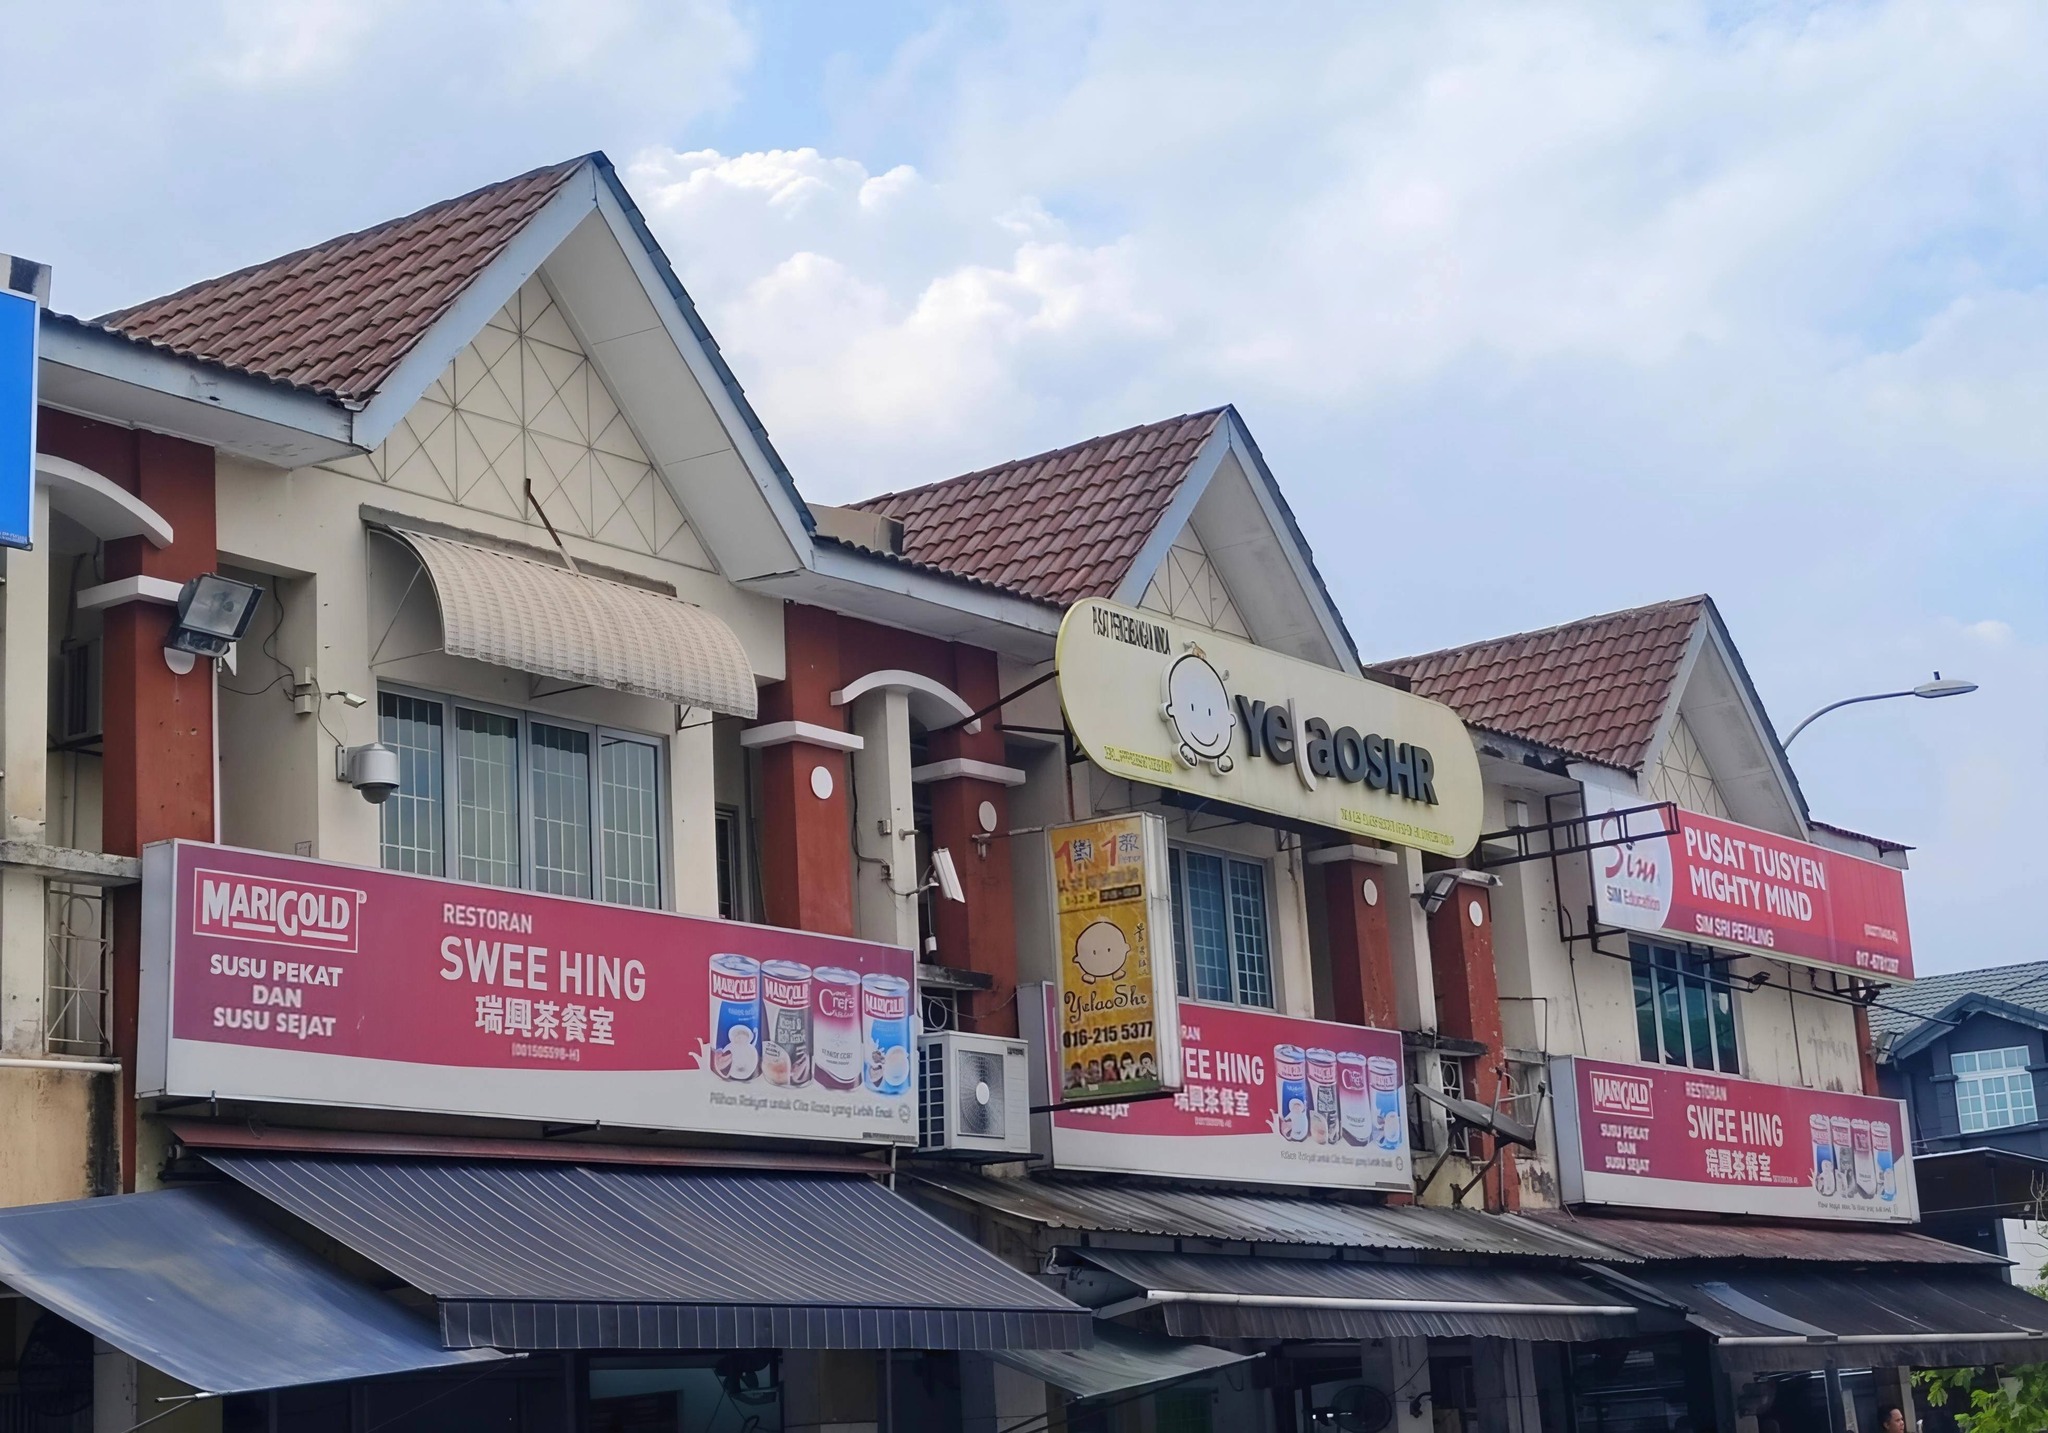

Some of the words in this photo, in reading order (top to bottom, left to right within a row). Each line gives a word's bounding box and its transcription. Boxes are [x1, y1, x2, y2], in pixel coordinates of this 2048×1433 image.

[1684, 826, 1746, 870] PUSAT
[1748, 843, 1826, 891] TUISYEN
[202, 879, 350, 937] MARIGOLD
[1689, 864, 1760, 910] MIGHTY
[1764, 882, 1812, 921] MIND
[443, 903, 533, 935] RESTORAN
[1695, 913, 1714, 934] SIM
[1714, 917, 1731, 939] SRI
[1731, 921, 1774, 947] PETALING
[210, 953, 267, 980] SUSU
[272, 960, 344, 988] PEKAT
[440, 935, 548, 992] SWEE
[560, 950, 646, 1002] HING
[252, 984, 303, 1008] DAN
[213, 1006, 270, 1031] SUSU
[276, 1011, 337, 1040] SEJAT
[475, 994, 615, 1046] 瑞興茶餐室
[1063, 1025, 1118, 1048] 016-215
[1121, 1021, 1153, 1041] 5377
[1215, 1050, 1264, 1086] HING
[1593, 1077, 1649, 1111] MARIGOLD
[1685, 1081, 1727, 1101] RESTORAN
[1099, 1103, 1129, 1120] SEJAT
[1687, 1104, 1738, 1143] SWEE
[1740, 1110, 1783, 1148] HING
[1600, 1123, 1621, 1138] SUSU
[1622, 1125, 1650, 1141] PEKAT
[1617, 1141, 1637, 1155] DAN
[1605, 1156, 1626, 1170] SUSU
[1627, 1157, 1650, 1174] SEJAT
